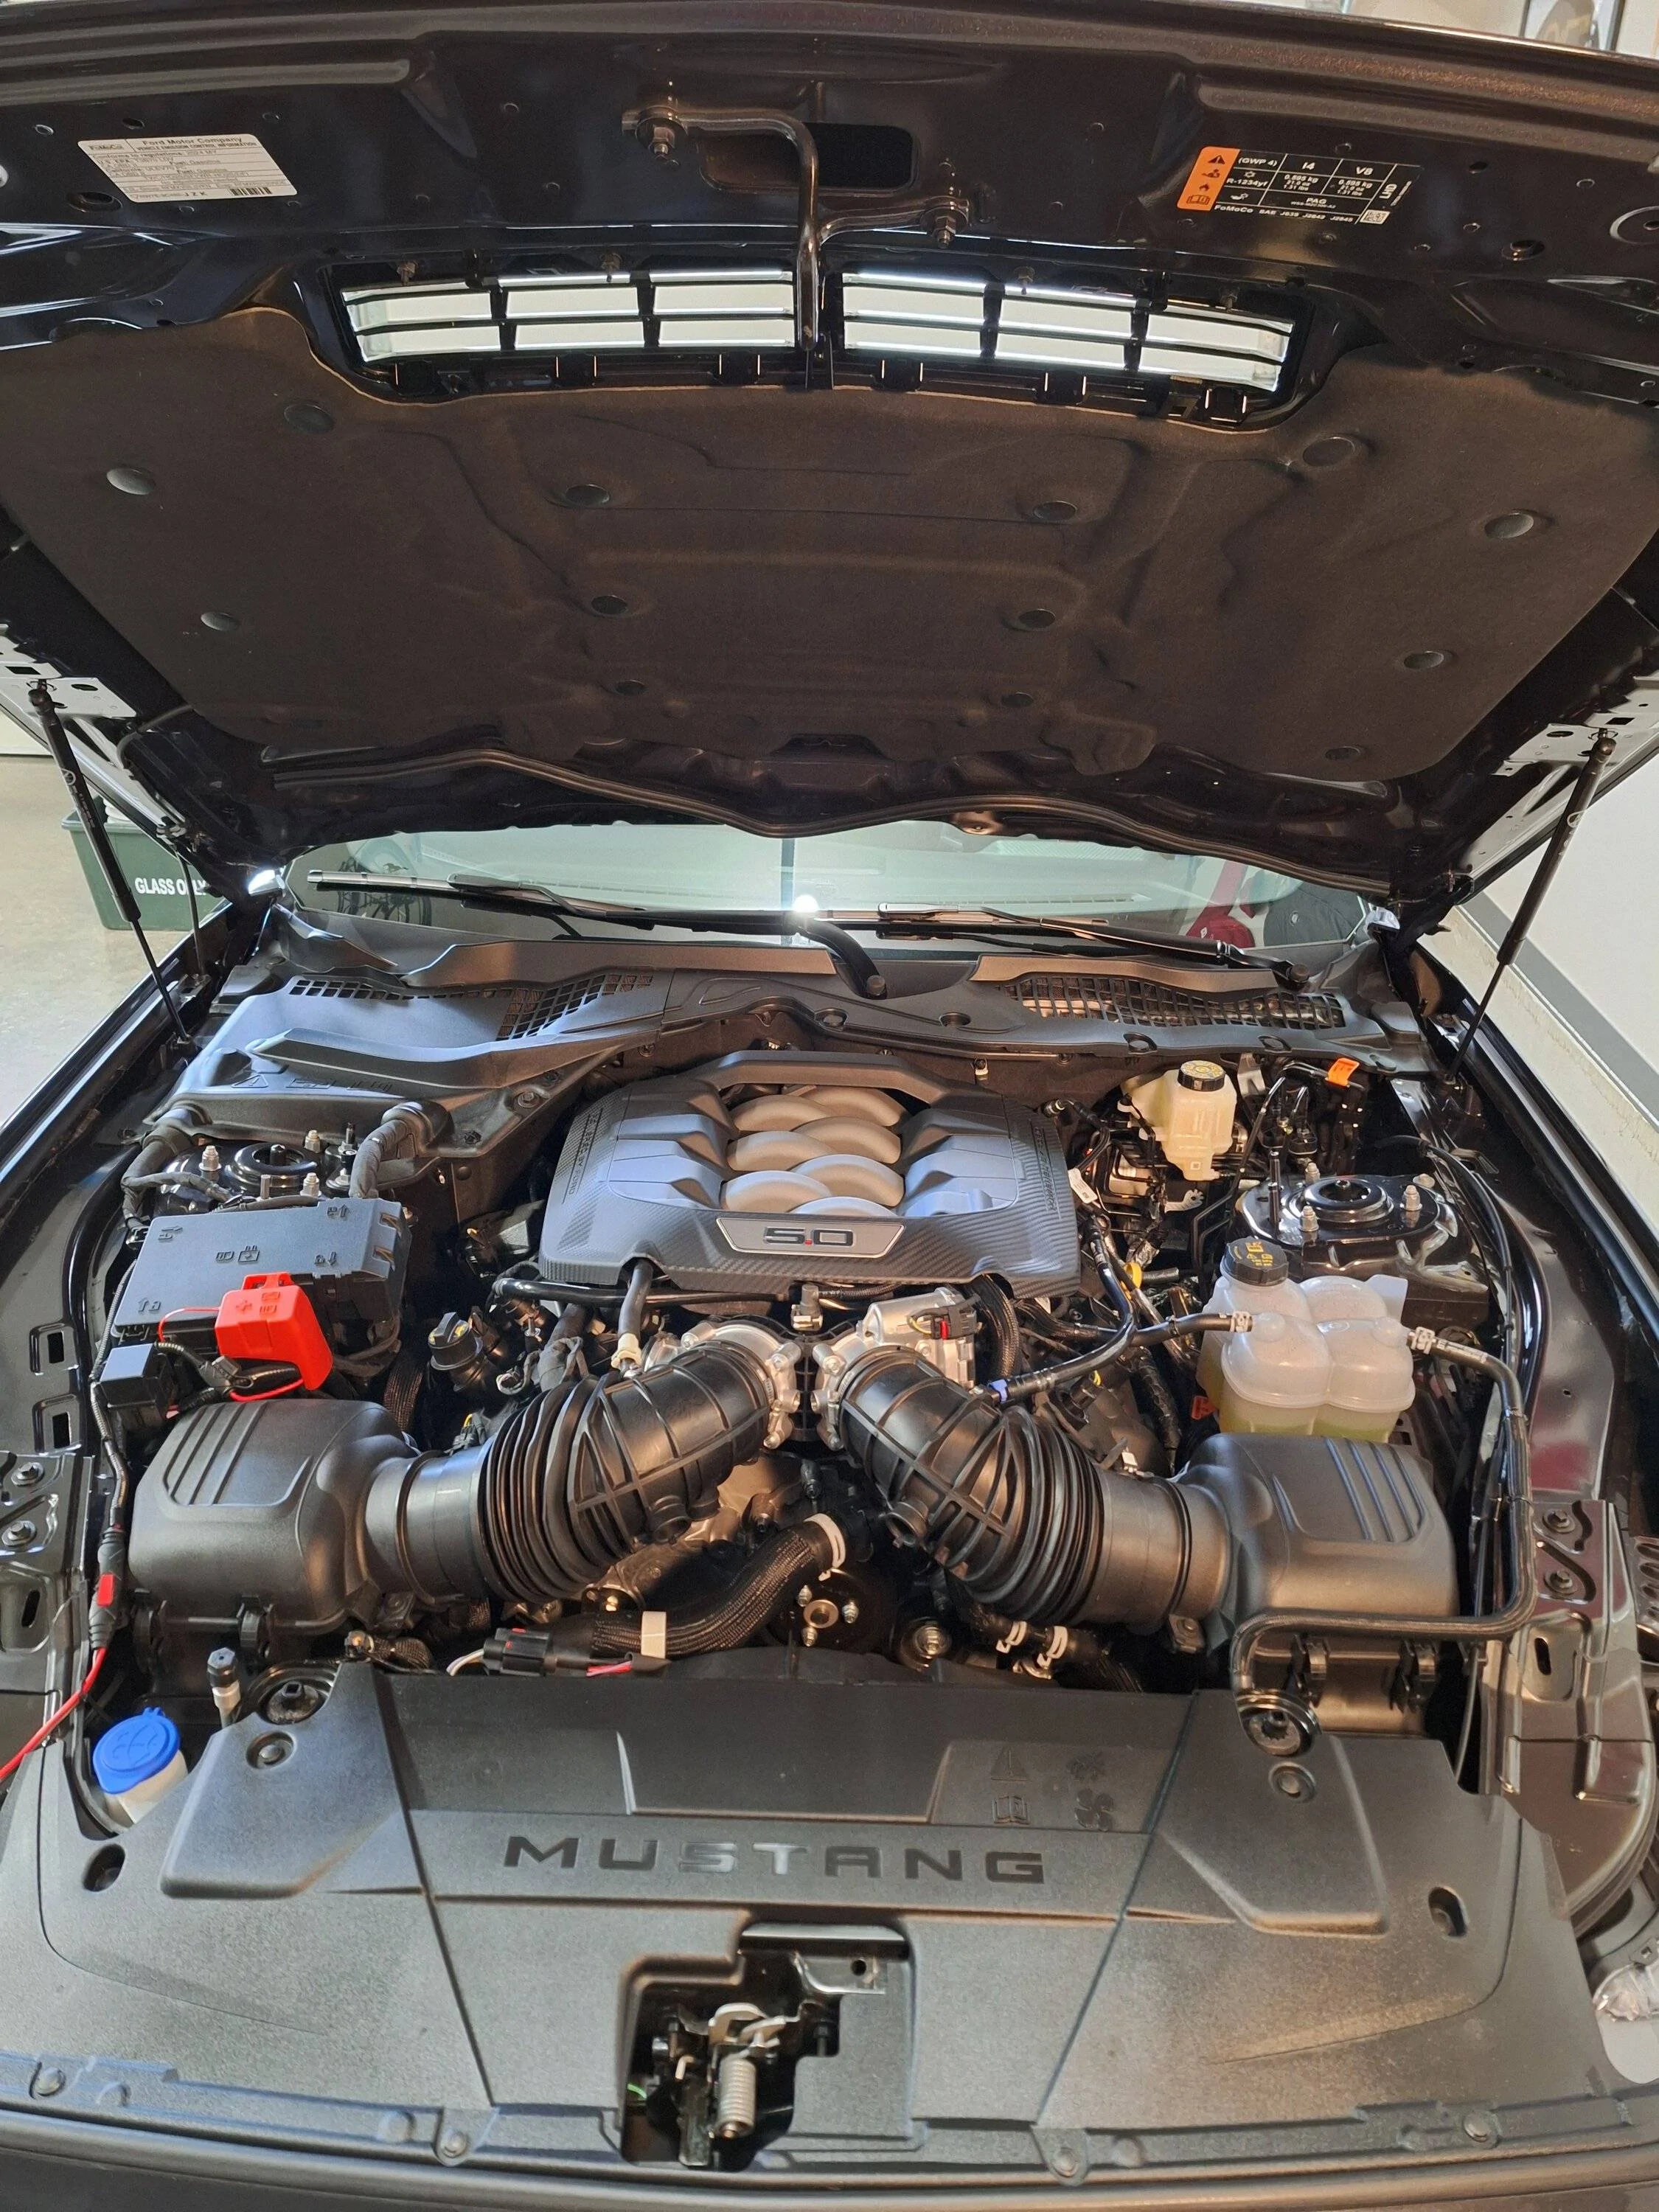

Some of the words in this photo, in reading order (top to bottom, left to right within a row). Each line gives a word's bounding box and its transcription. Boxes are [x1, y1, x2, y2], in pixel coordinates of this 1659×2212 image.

[1237, 157, 1266, 165] (GWP
[1301, 161, 1316, 170] I4
[1353, 167, 1374, 175] V8
[1225, 178, 1268, 187] R-1234yf
[1378, 183, 1398, 199] LHD
[1213, 205, 1255, 213] FoMoCo
[135, 877, 175, 895] GLASS
[176, 878, 206, 895] OLY
[764, 1227, 854, 1247] 5.0
[504, 1835, 1046, 1885] MUSTANG
